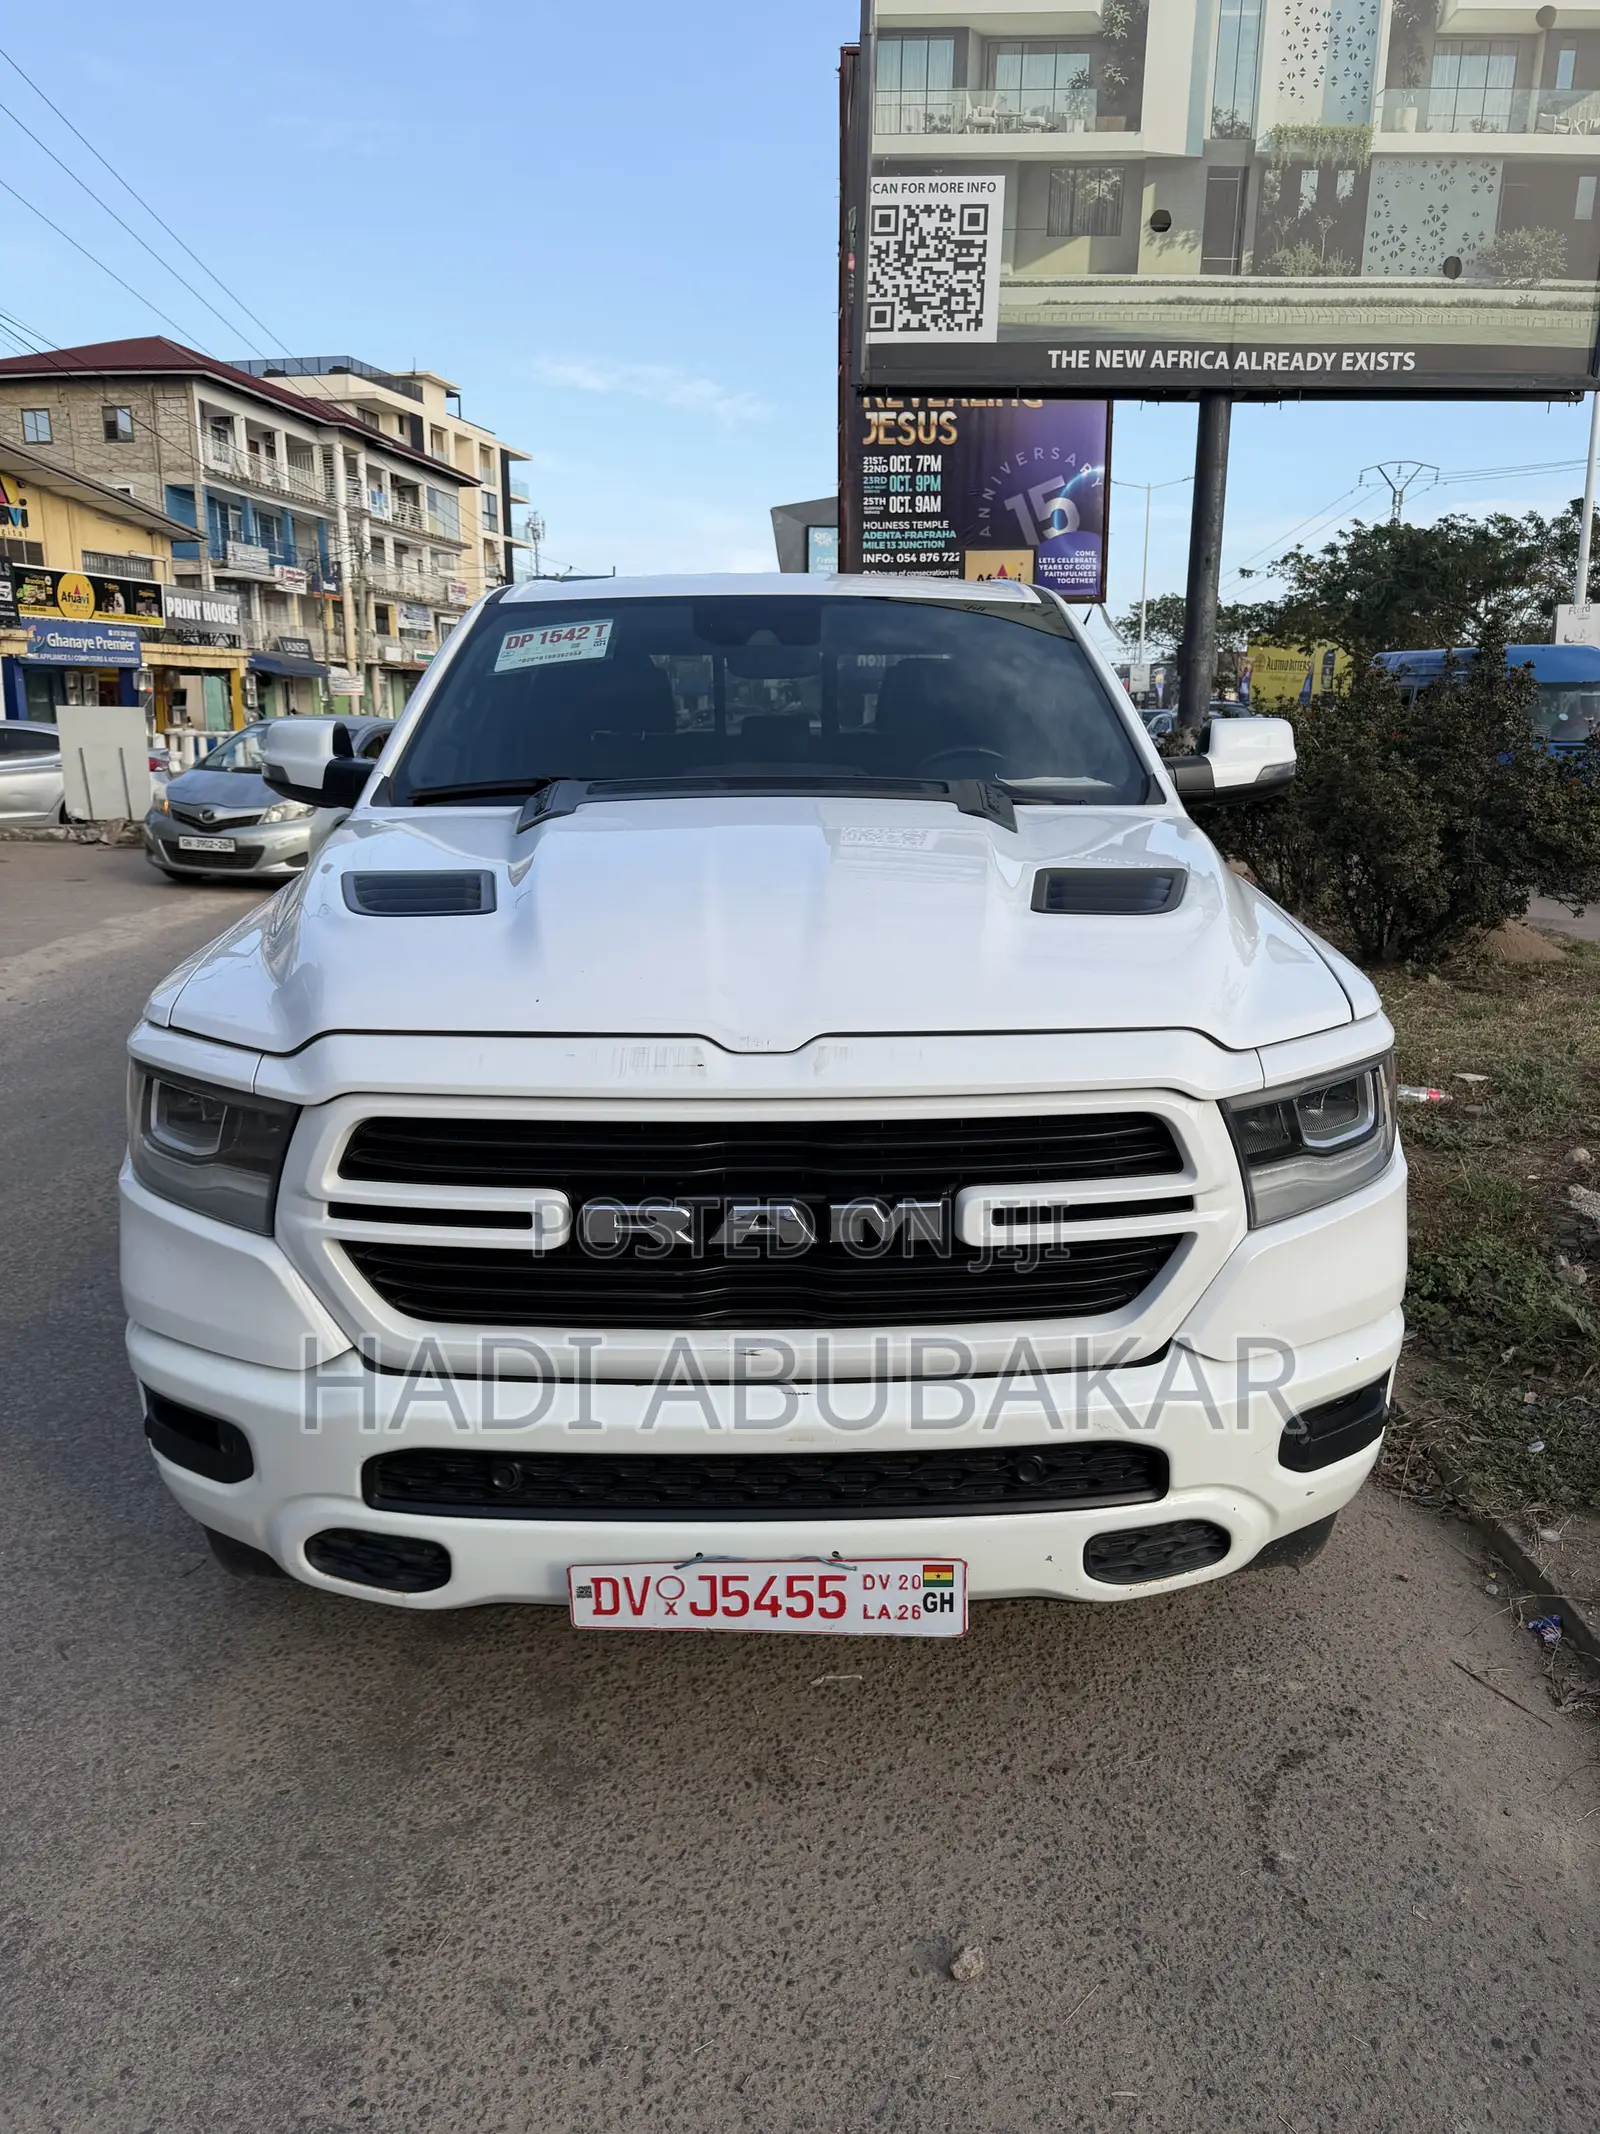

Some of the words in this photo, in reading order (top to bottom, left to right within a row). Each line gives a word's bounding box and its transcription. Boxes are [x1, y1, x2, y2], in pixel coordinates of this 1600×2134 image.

[871, 183, 898, 194] CAN
[901, 183, 925, 193] FOR
[928, 182, 964, 193] MORE
[967, 182, 996, 193] INFO
[1048, 350, 1090, 369] THE
[1095, 350, 1147, 369] NEW
[1150, 350, 1230, 370] AFRICA
[1234, 352, 1337, 371] ALREADY
[1341, 352, 1416, 371] EXISTS
[862, 411, 958, 446] JESUS
[863, 465, 888, 473] 22ND
[889, 455, 913, 473] OCT.
[916, 455, 942, 472] 7PM
[863, 477, 887, 485] 23RD
[889, 475, 913, 492] OCT.
[916, 475, 941, 492] 9PM
[863, 497, 886, 506] 25TH
[889, 496, 913, 513] OCT.
[915, 496, 941, 513] 9AM
[1004, 475, 1080, 546] 15
[863, 521, 910, 530] HOLINESS
[912, 520, 949, 529] TEMPLE
[863, 530, 957, 540] ADENTA-FRAFRAHA
[863, 541, 886, 550] MILE
[897, 540, 945, 549] JUNCTION
[863, 553, 894, 563] INFO:
[896, 553, 917, 563] 054
[919, 552, 940, 562] 876
[61, 591, 90, 604] Afuavi
[165, 596, 201, 620] PRINT
[202, 601, 238, 625] HOUSE
[47, 633, 94, 652] Ghanaye
[96, 636, 136, 652] Premier
[505, 633, 534, 650] DP
[540, 626, 591, 645] 1542
[595, 624, 608, 638] T
[583, 1205, 942, 1244] RAM
[863, 1574, 890, 1591] DV
[899, 1575, 921, 1590] 20
[592, 1576, 651, 1616] DV
[690, 1575, 847, 1618] J5455
[923, 1592, 954, 1613] GH
[863, 1604, 889, 1620] LA
[899, 1605, 921, 1620] 26
